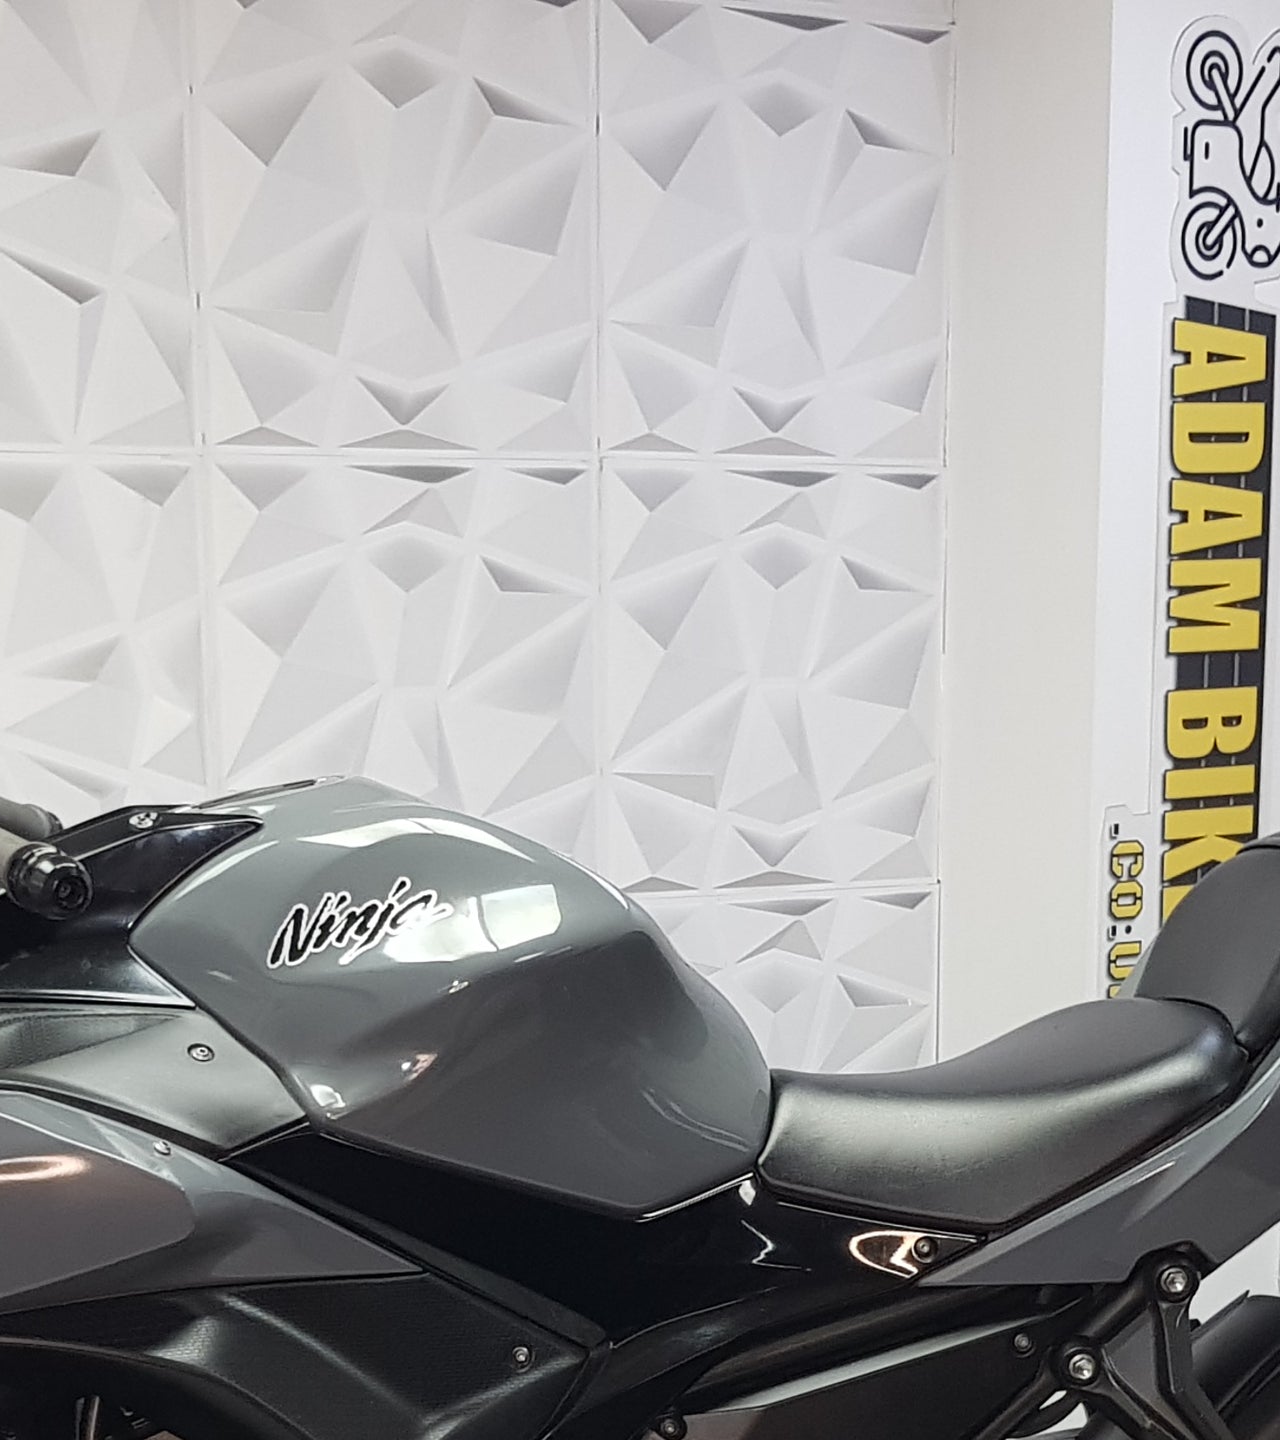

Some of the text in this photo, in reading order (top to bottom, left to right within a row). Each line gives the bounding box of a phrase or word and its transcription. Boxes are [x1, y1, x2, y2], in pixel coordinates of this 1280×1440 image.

[1160, 317, 1268, 927] ADAM BIK
[266, 876, 454, 969] Ninja
[1108, 822, 1144, 999] .CO.U
